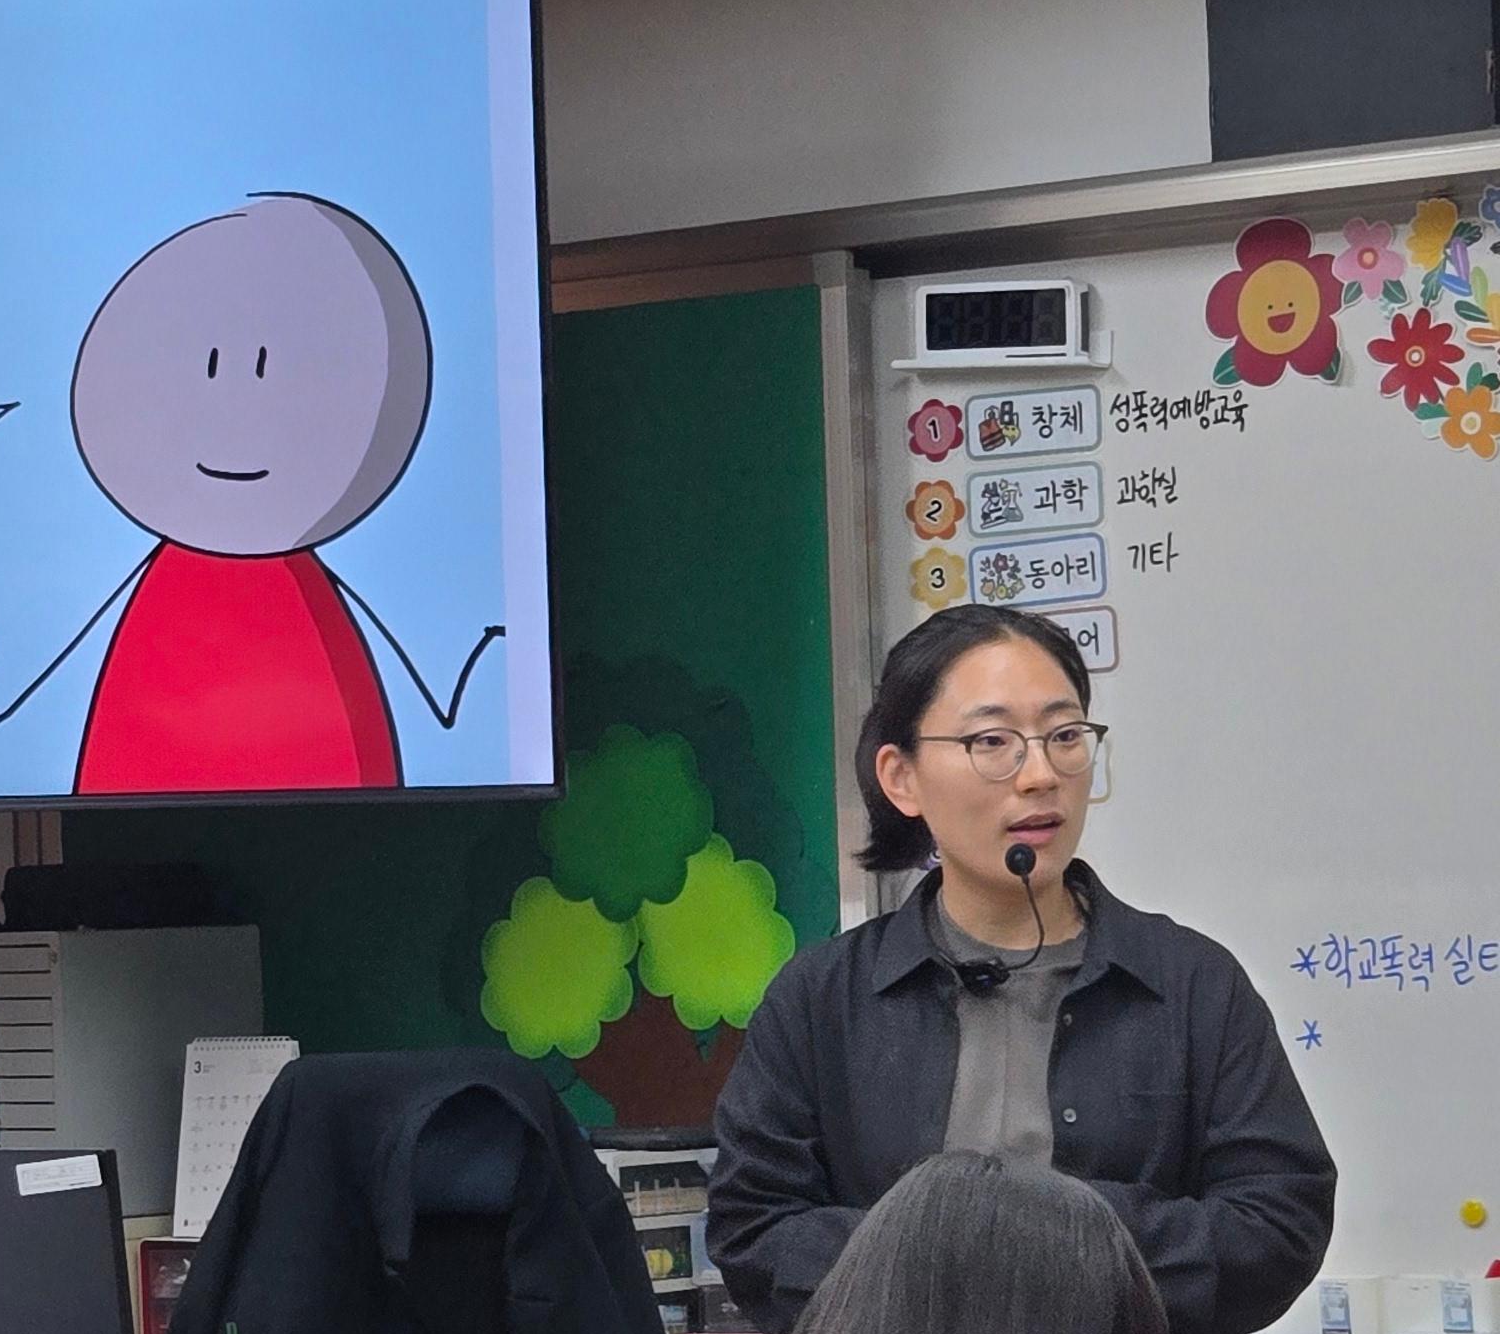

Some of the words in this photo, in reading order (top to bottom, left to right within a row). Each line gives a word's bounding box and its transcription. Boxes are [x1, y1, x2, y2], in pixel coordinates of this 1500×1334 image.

[927, 417, 941, 440] 1
[1031, 400, 1084, 437] 창체
[1109, 389, 1249, 434] 성폭력예방교육
[1033, 479, 1088, 514] 과학
[1115, 465, 1179, 509] 과학실
[925, 500, 942, 522] 2
[1024, 551, 1097, 588] 동아리
[1126, 530, 1180, 574] 기타
[930, 567, 946, 589] 3
[193, 1060, 203, 1075] 3
